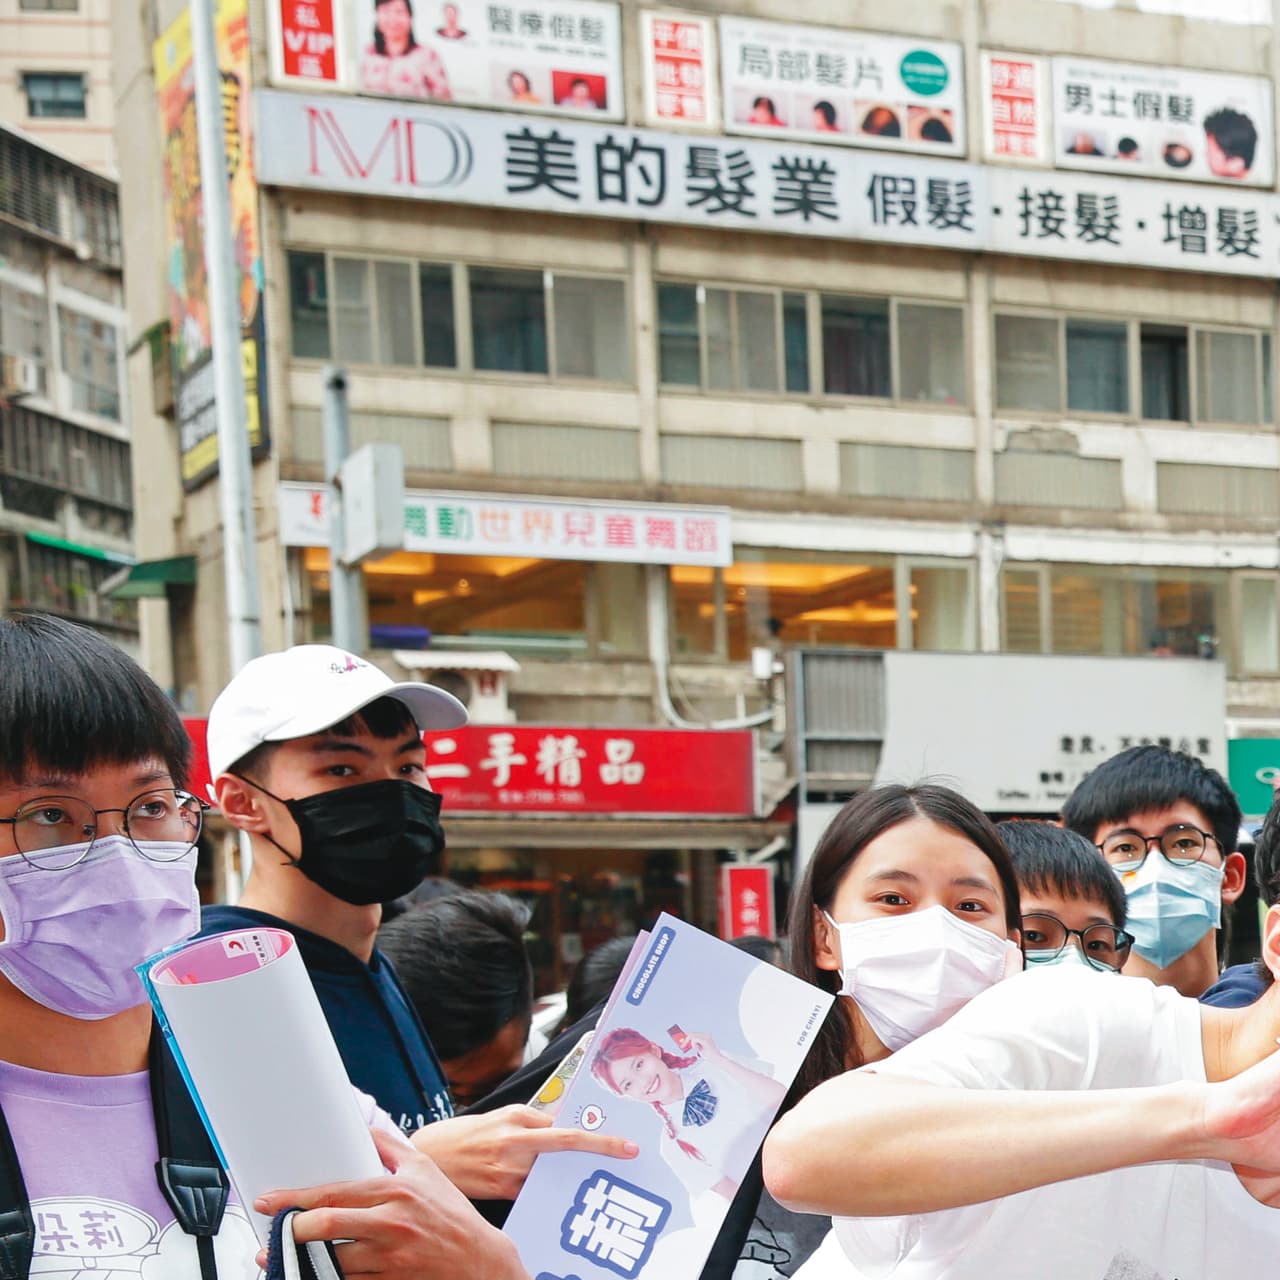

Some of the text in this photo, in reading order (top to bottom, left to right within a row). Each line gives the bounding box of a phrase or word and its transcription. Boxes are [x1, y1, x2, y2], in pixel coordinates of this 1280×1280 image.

[284, 29, 334, 52] VIP
[737, 44, 884, 90] 局部髮片
[1065, 84, 1195, 125] 男士假髮
[505, 128, 841, 221] 美的髮業
[425, 732, 646, 787] 二手精品
[632, 957, 660, 1000] CHOCOLATE
[38, 1209, 124, 1252] 朵莉
